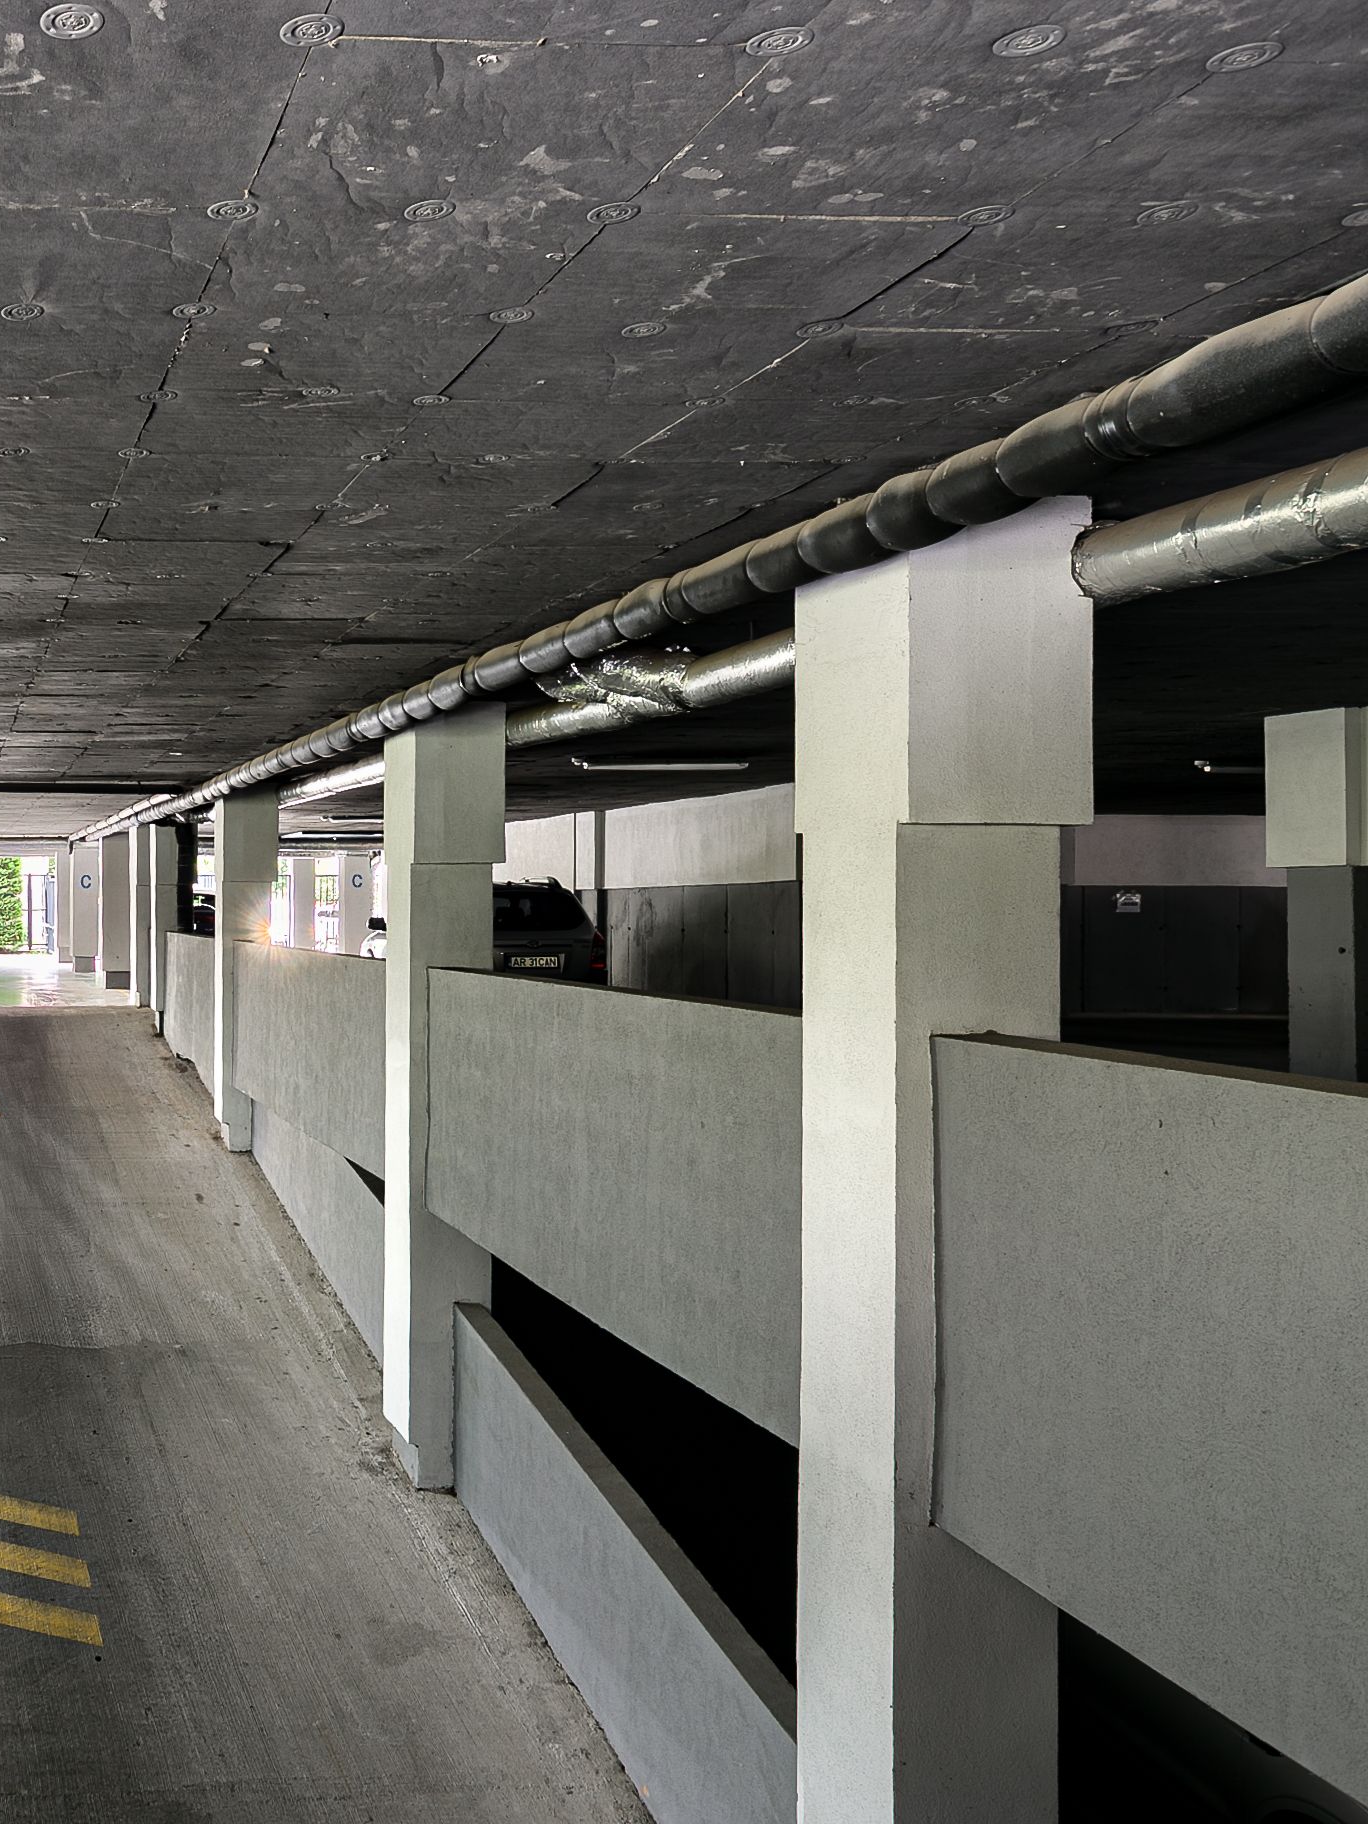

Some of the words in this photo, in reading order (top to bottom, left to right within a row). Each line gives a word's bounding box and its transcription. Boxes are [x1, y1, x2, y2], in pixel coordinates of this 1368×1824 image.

[80, 874, 92, 889] C
[351, 873, 363, 888] C
[512, 957, 526, 967] AR
